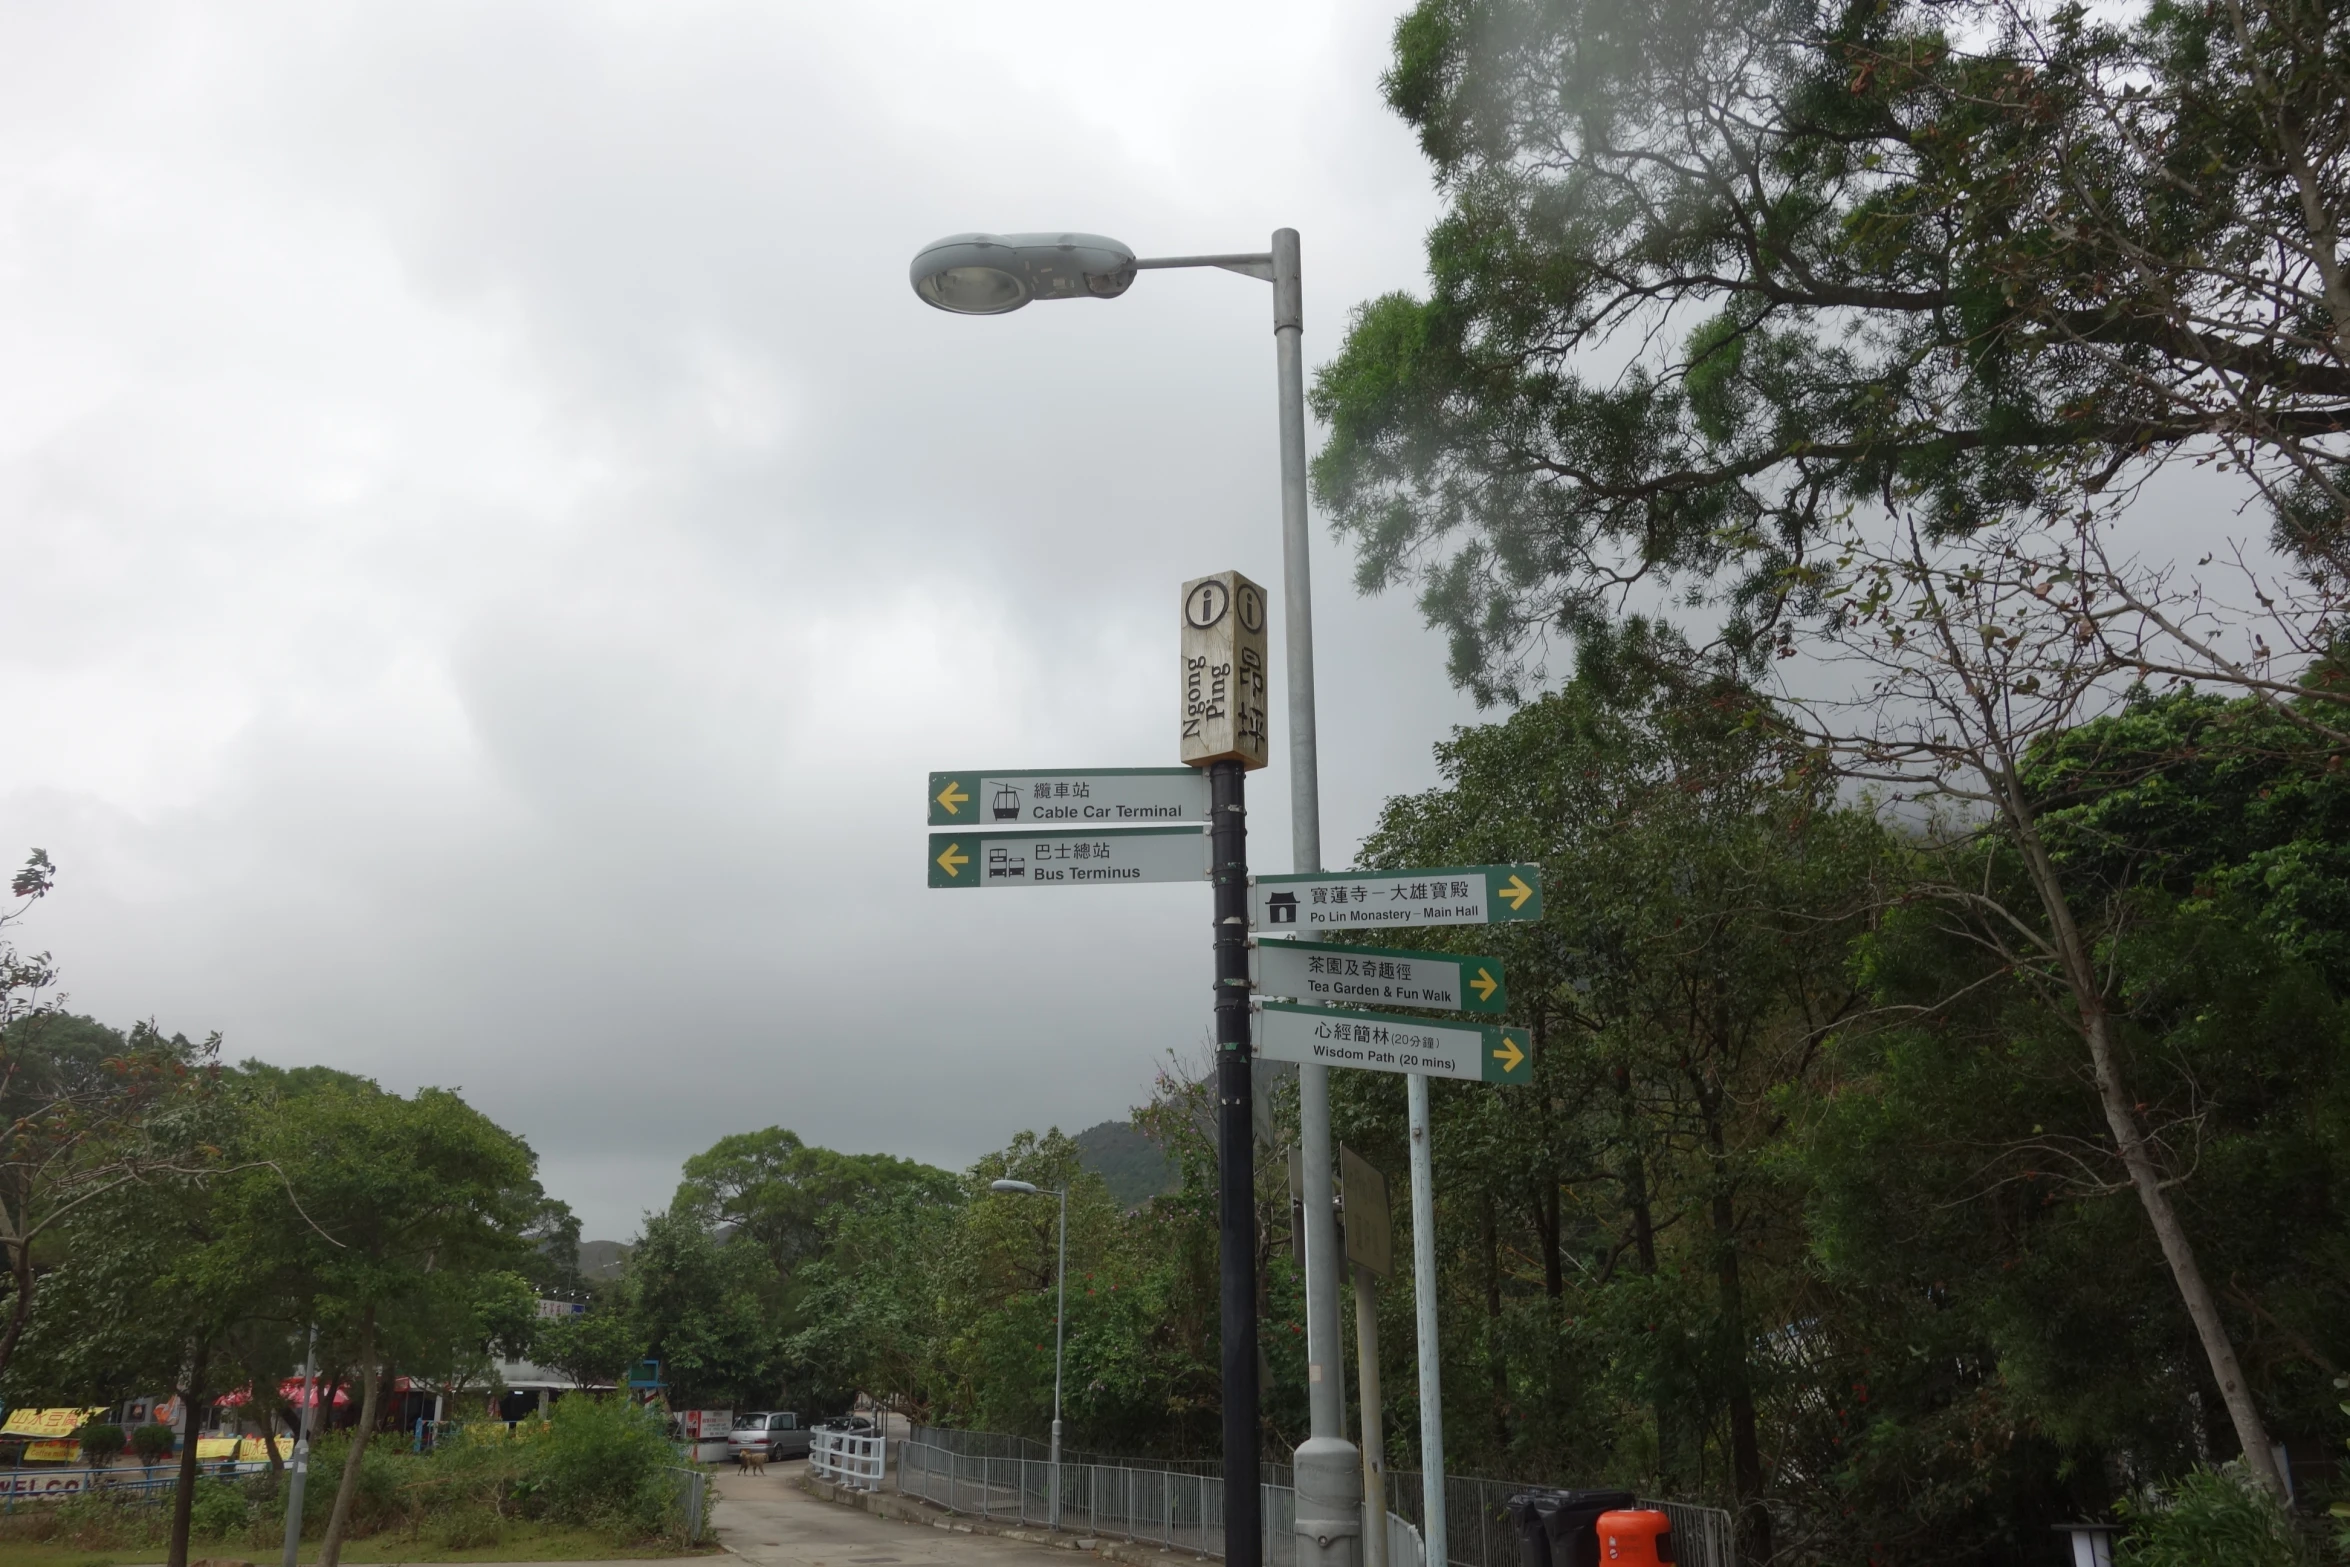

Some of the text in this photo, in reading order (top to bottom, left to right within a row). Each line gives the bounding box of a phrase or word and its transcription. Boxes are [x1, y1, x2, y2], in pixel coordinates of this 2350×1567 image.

[1183, 655, 1207, 741] Ngong
[1206, 662, 1231, 722] Ping
[1238, 647, 1265, 752] 昂坪
[1033, 781, 1090, 799] 纜車站
[1033, 804, 1182, 819] Cable Car Terminal
[1034, 842, 1111, 860] 巴士總站
[1034, 865, 1141, 881] Bus Terminus
[1310, 911, 1325, 923] Po
[1329, 910, 1347, 922] Lin
[1350, 909, 1411, 922] Monastery
[1423, 907, 1453, 918] Main
[1455, 905, 1478, 917] Hall
[1308, 955, 1412, 981] 茶園及奇趣徑
[1308, 979, 1452, 1003] Tea Garden & Fun Walk
[1313, 1045, 1456, 1071] Wisdom Path (20 mins)
